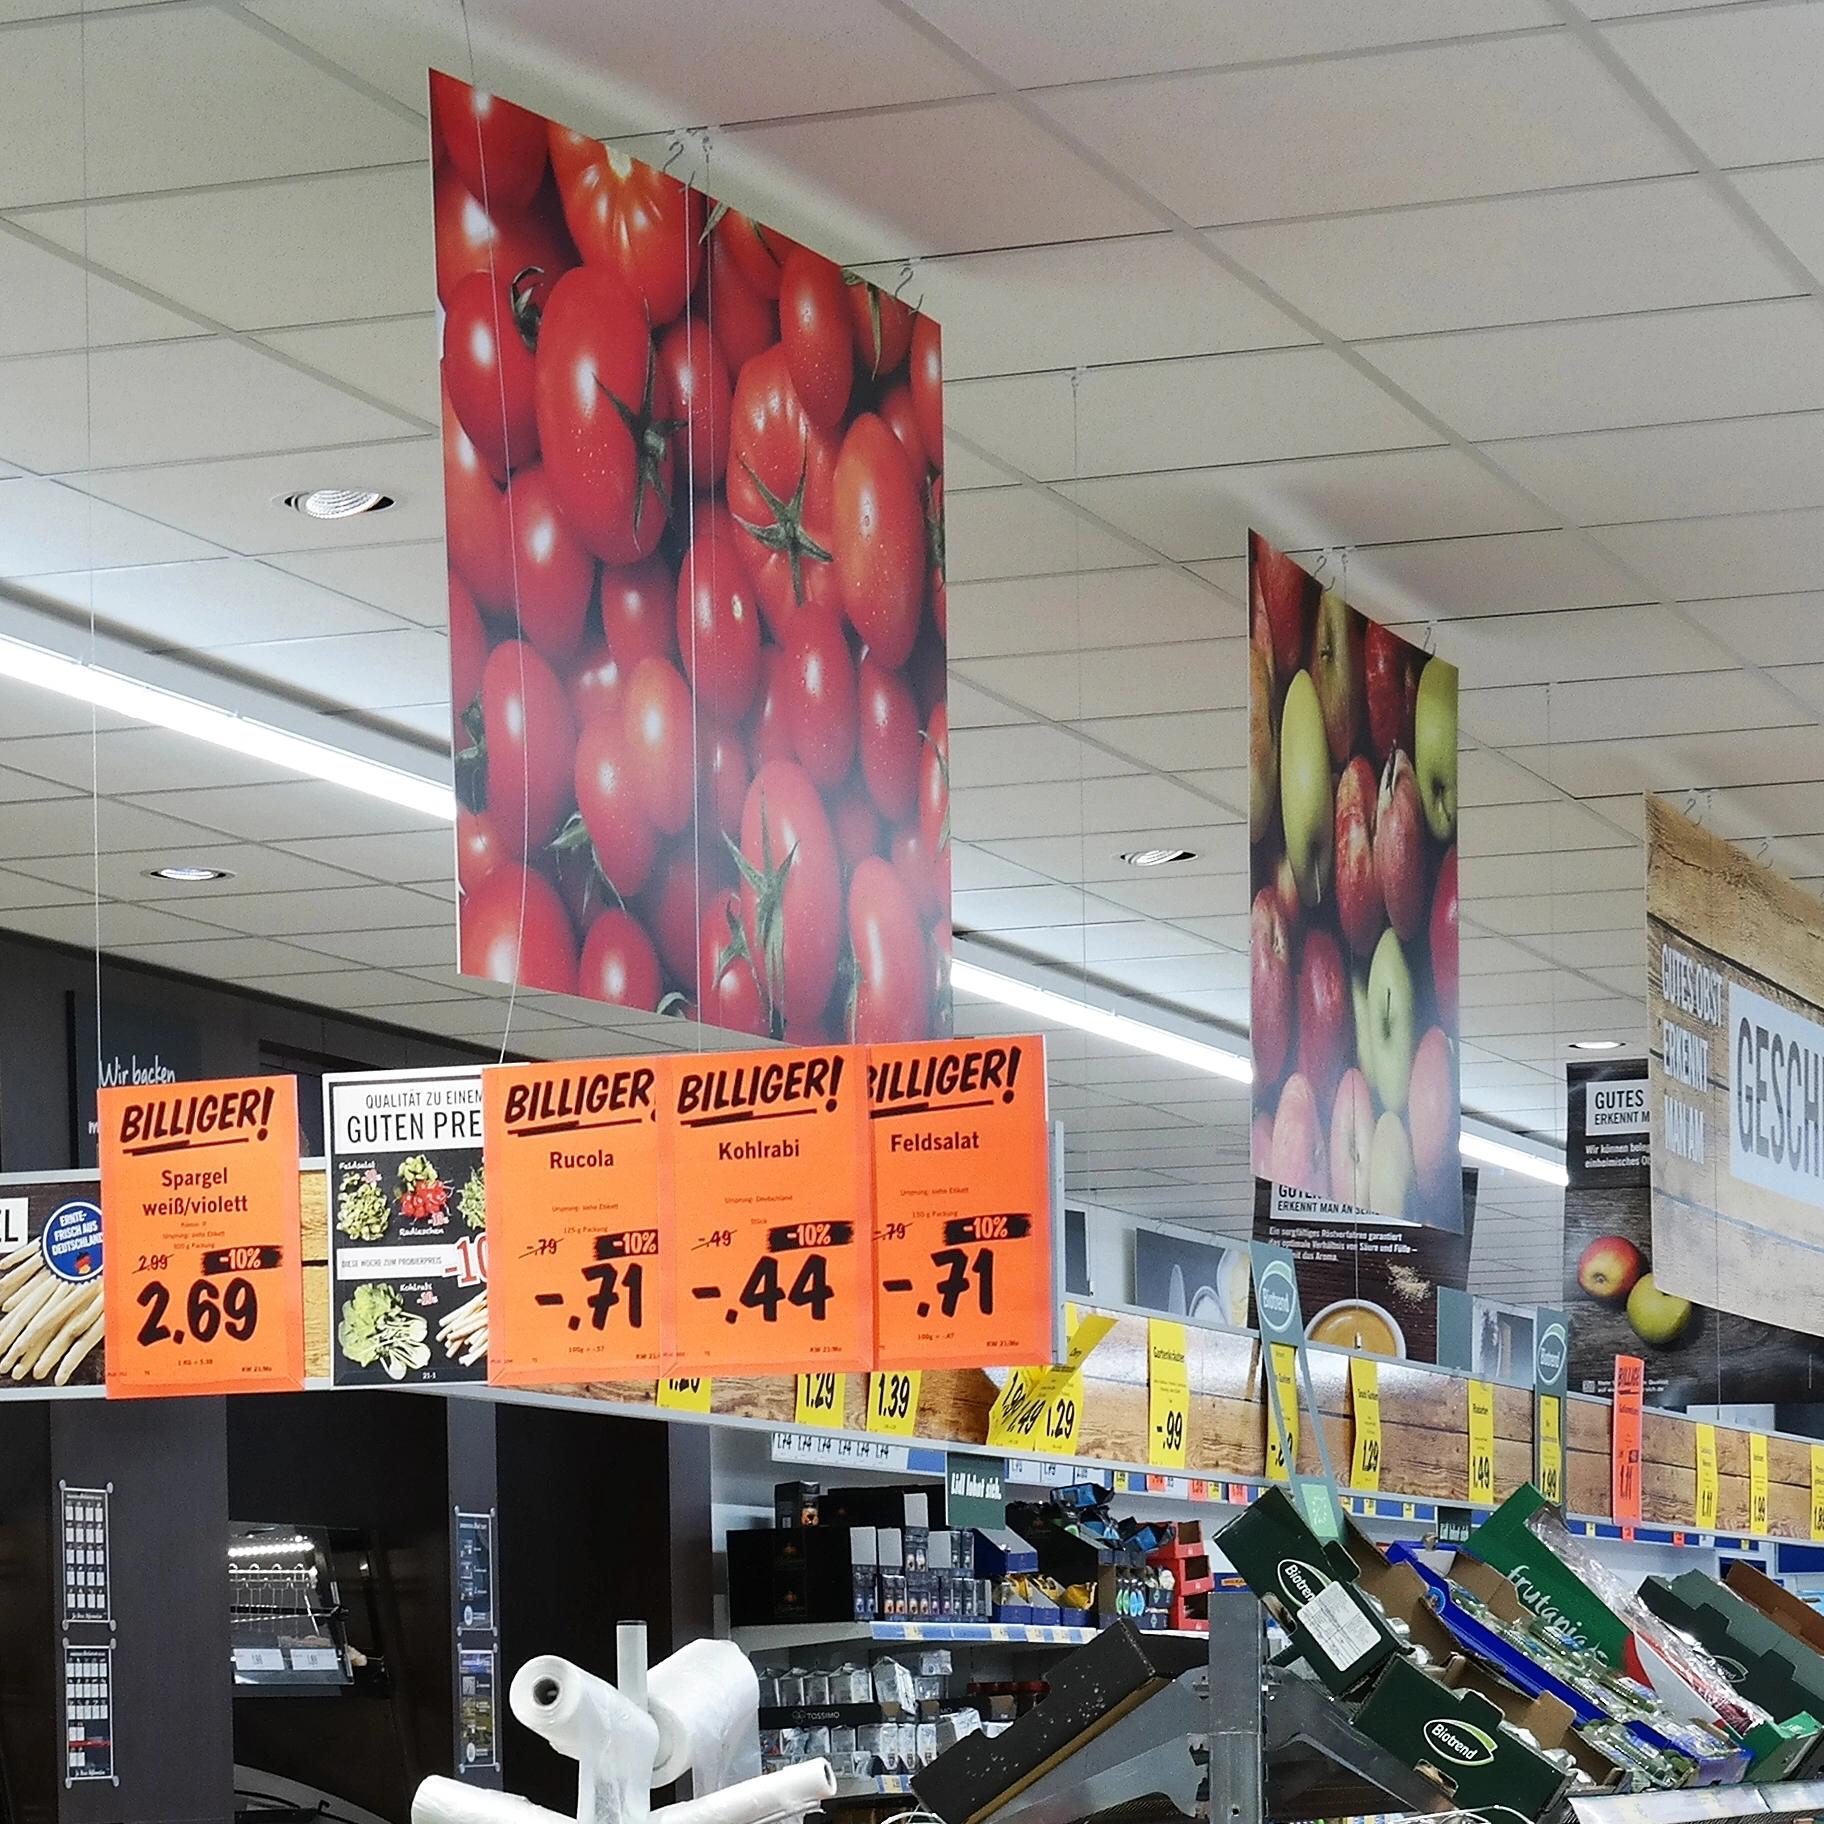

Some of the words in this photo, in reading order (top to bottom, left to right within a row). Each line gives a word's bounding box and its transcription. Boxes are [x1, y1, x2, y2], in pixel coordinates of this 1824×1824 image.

[100, 1060, 129, 1087] Wir
[132, 1055, 175, 1085] backen
[677, 1055, 845, 1114] BILLIGER!
[365, 1089, 423, 1110] QUALITÄT
[426, 1091, 442, 1106] ZU
[1594, 1089, 1644, 1110] GUTES
[120, 1086, 275, 1143] BILLIGER!
[1594, 1111, 1639, 1125] ERKENNT
[347, 1111, 424, 1144] GUTEN
[718, 1139, 801, 1161] Kohlrabi
[891, 1131, 980, 1153] Feldsalat
[549, 1150, 615, 1170] Rucola
[161, 1167, 228, 1190] Spargel
[142, 1195, 249, 1218] weiß/violett
[1277, 1200, 1318, 1212] ERKENNT
[1319, 1202, 1339, 1213] MAN
[786, 1223, 832, 1246] -10%
[963, 1216, 1009, 1239] -10%
[612, 1231, 658, 1255] -10%
[136, 1252, 170, 1273] 2.99
[219, 1247, 262, 1271] -10%
[691, 1253, 835, 1325] -.44
[882, 1247, 995, 1319] -.71
[534, 1263, 643, 1331] -.71
[136, 1277, 259, 1348] 2.69
[805, 1373, 835, 1410] 1.29
[878, 1371, 910, 1419] 1.39
[1045, 1399, 1075, 1440] 1.29
[1156, 1410, 1183, 1451] -.99
[1472, 1455, 1490, 1489] 1.49
[807, 1711, 841, 1721] TOSSIMO
[1429, 1723, 1480, 1762] Biotrend
